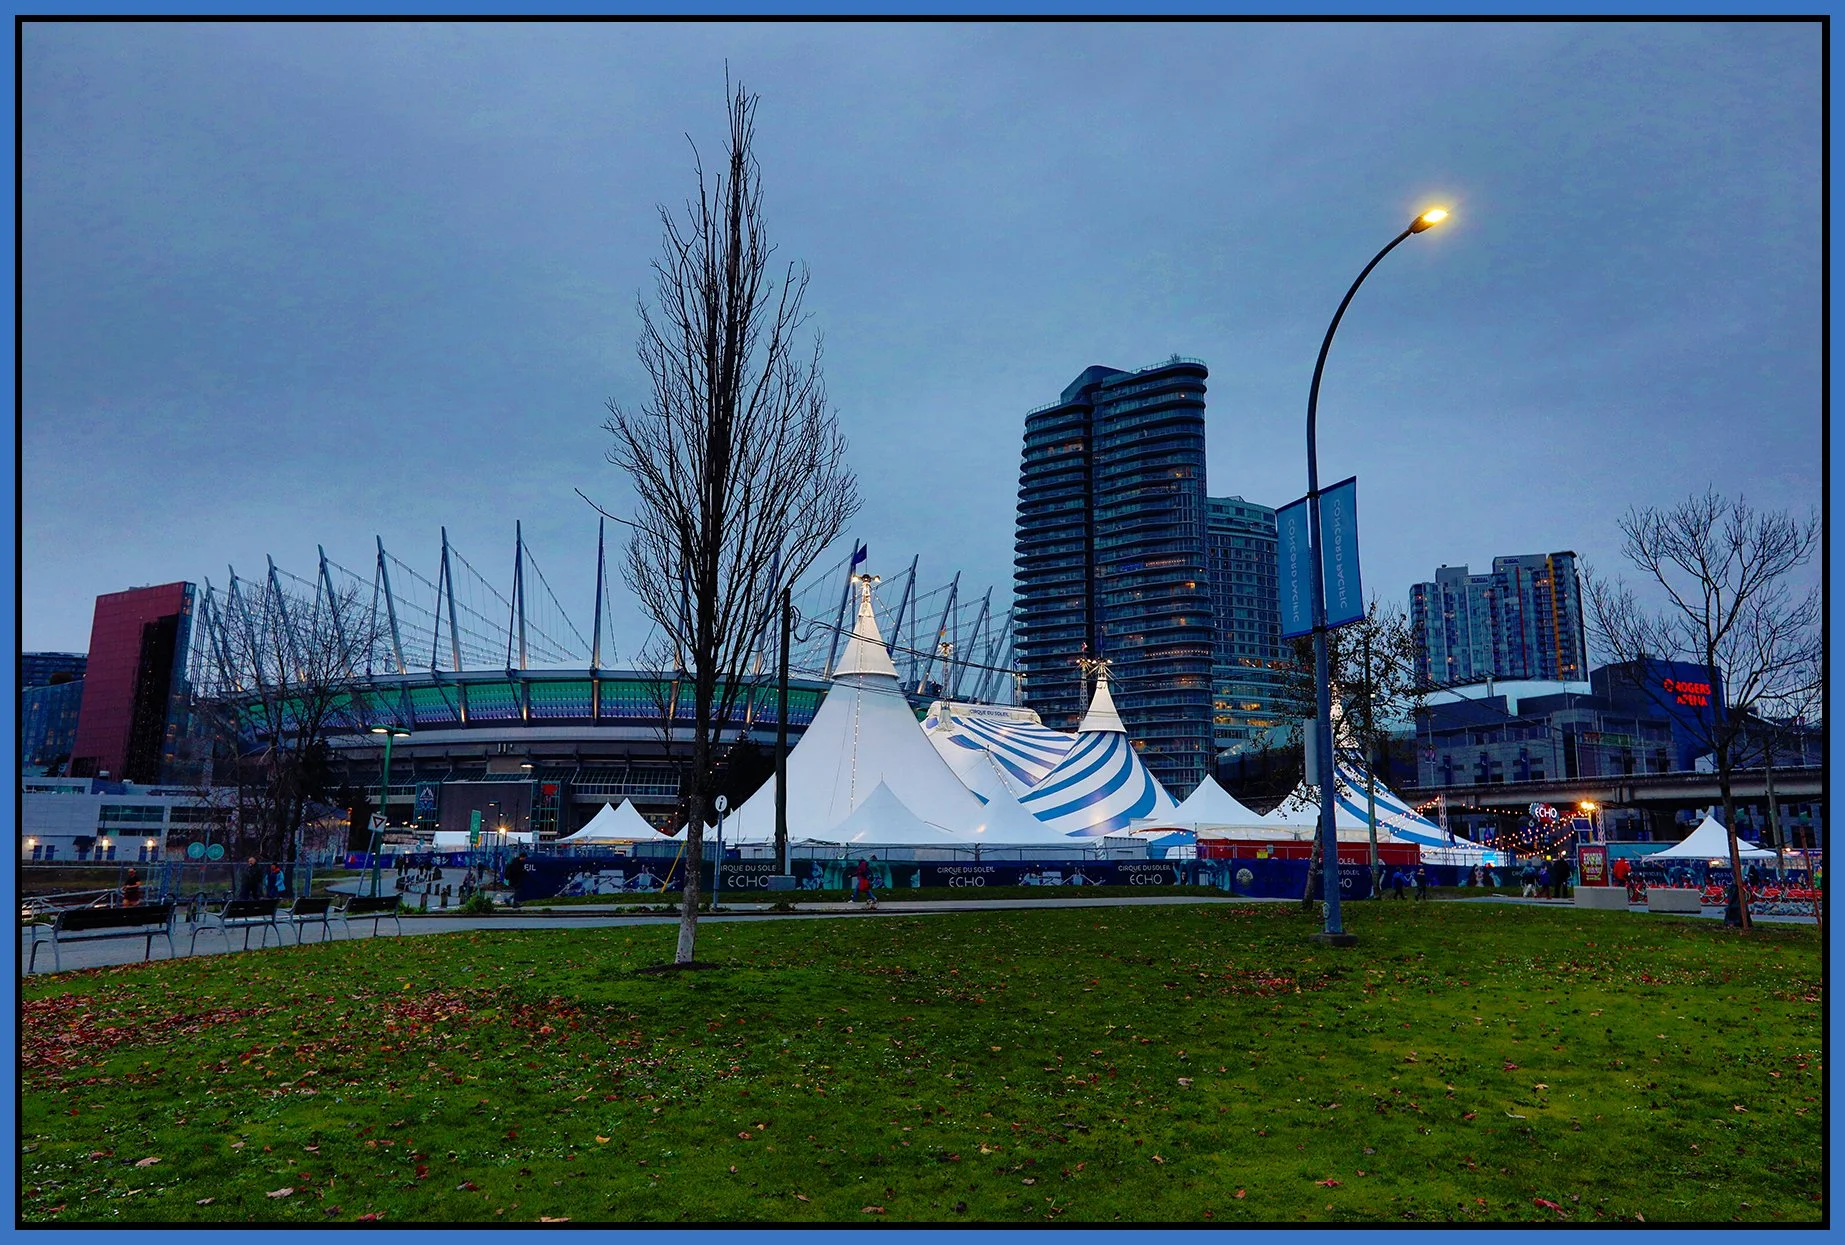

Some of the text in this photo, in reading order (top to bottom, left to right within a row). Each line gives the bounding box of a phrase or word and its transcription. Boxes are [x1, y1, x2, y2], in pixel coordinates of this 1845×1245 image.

[1675, 681, 1712, 696] ROGERS
[1534, 806, 1558, 819] ECHO
[720, 864, 777, 874] IRQUE DU SOLE
[937, 866, 962, 875] CIRQUE
[963, 866, 973, 874] DU
[1118, 864, 1142, 873] CIRQUE
[1142, 864, 1151, 872] DU
[728, 875, 769, 888] ECHO
[949, 876, 985, 888] ECHO
[1130, 873, 1163, 885] ECHO
